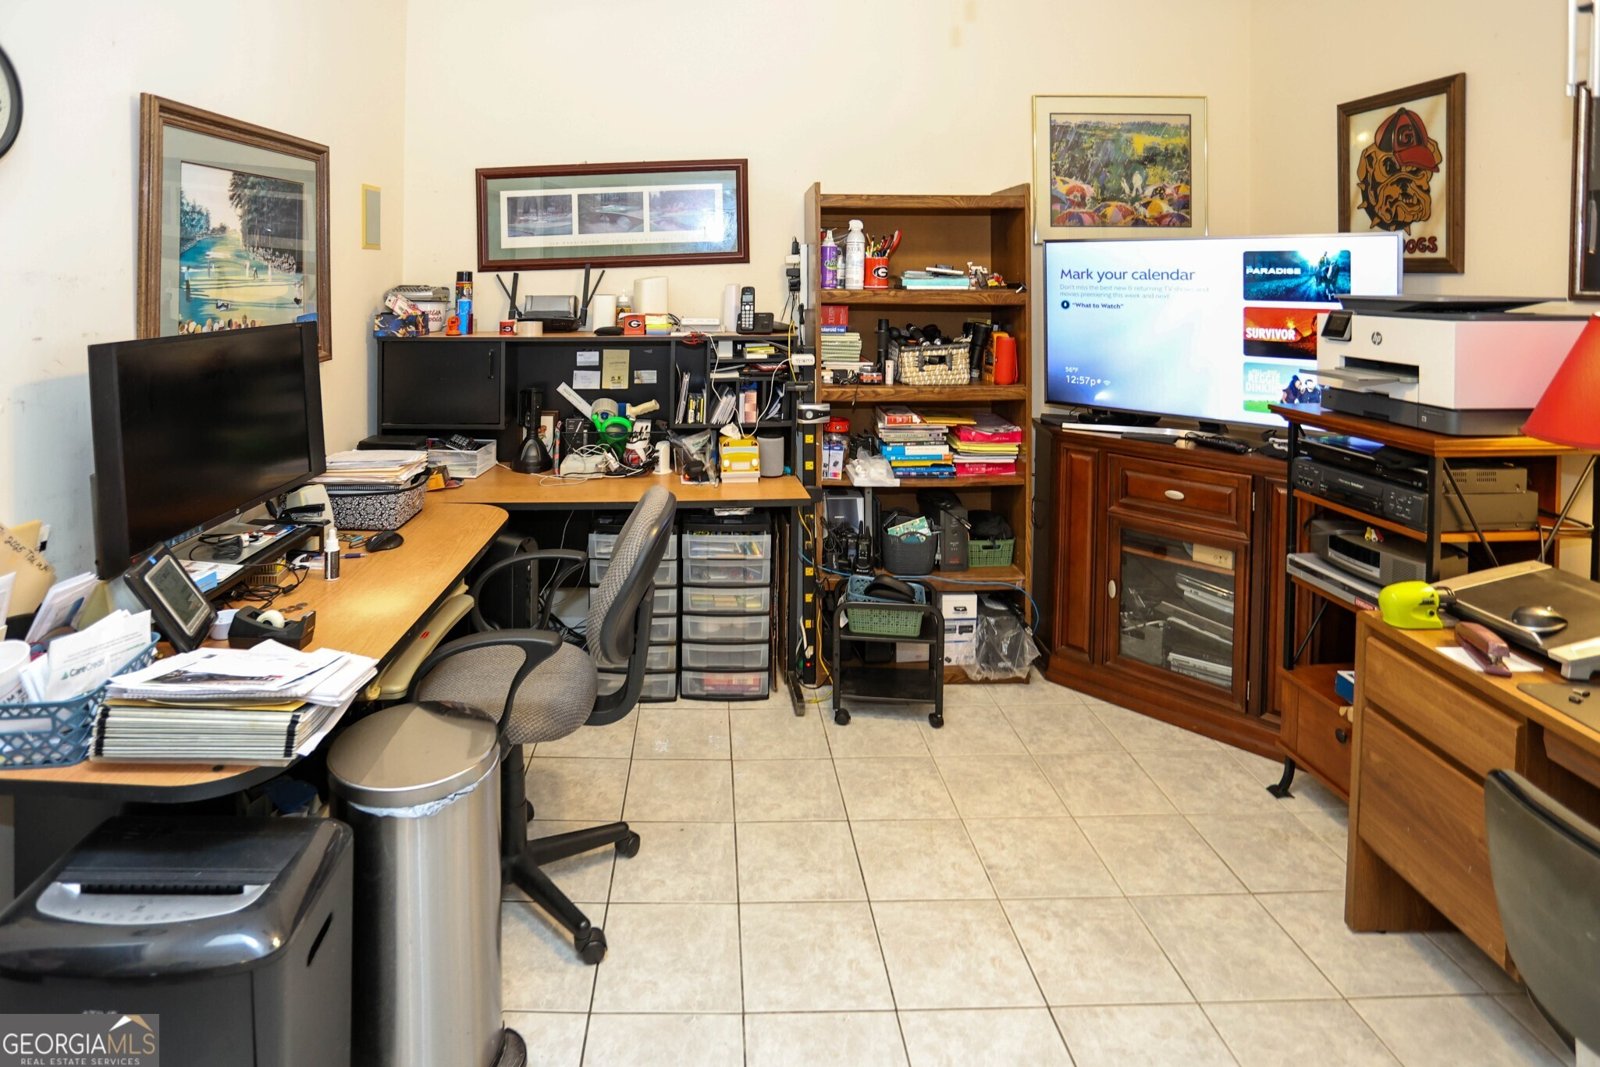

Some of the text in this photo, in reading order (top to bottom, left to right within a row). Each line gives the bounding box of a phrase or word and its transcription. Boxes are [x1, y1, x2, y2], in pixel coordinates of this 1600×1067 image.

[874, 265, 888, 278] G
[1060, 268, 1195, 283] Mark your calendar
[1246, 267, 1301, 275] PARADISE
[1245, 327, 1296, 340] SURVIVOR
[1066, 375, 1096, 387] 12:57p
[69, 658, 106, 678] CareCredit
